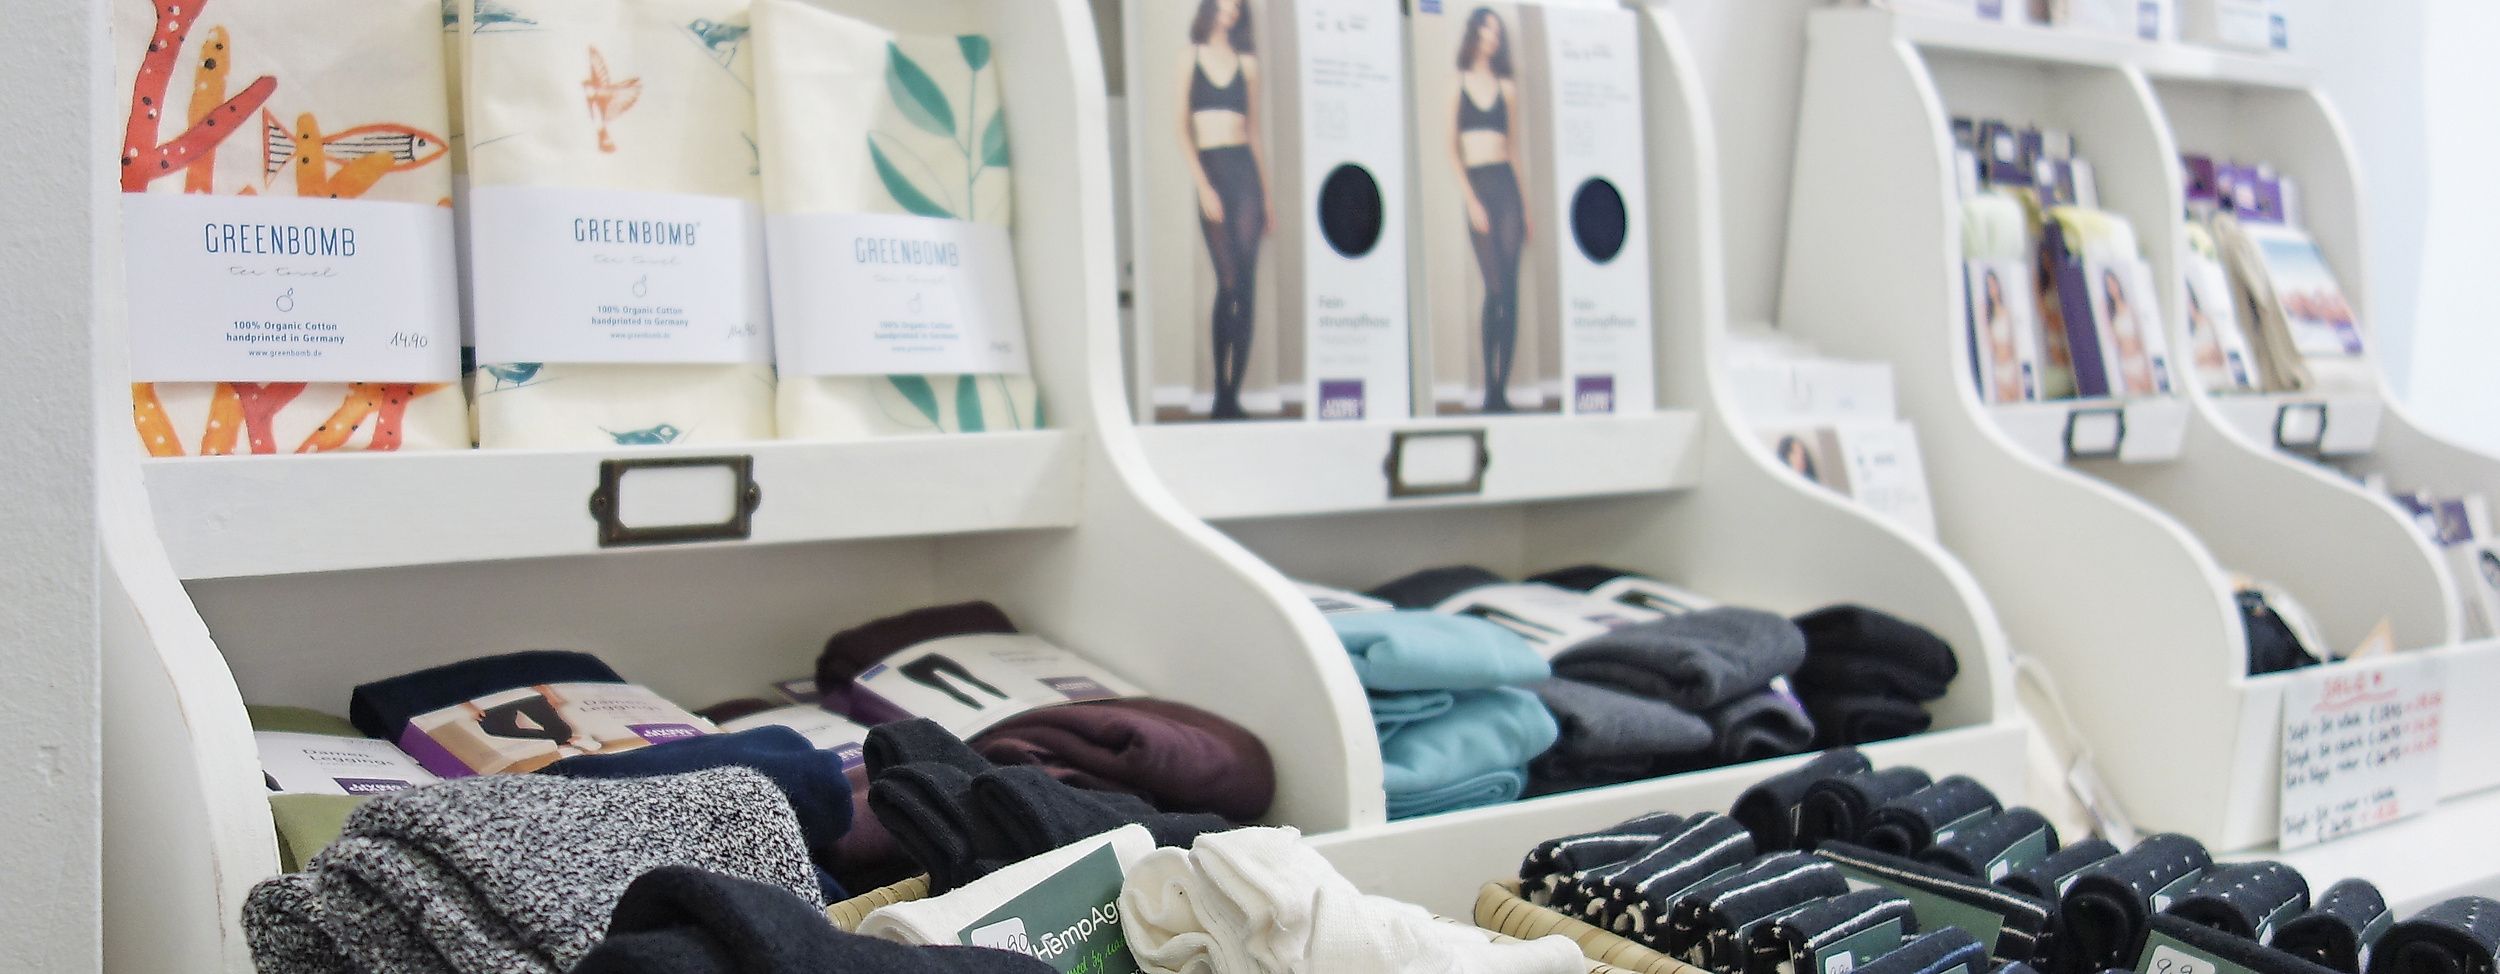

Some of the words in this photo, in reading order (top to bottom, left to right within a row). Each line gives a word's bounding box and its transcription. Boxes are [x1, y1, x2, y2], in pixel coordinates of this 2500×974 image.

[574, 218, 696, 247] GREENBOMB
[205, 223, 356, 257] GREENBOMB
[855, 237, 959, 267] GREENBOMB
[598, 306, 620, 315] 100%
[622, 306, 652, 316] Organic
[656, 306, 683, 315] Cotton
[234, 321, 261, 331] 100%
[264, 321, 302, 332] Organic
[305, 321, 338, 331] Cotton
[591, 316, 642, 327] handprinted
[644, 316, 652, 326] in
[654, 317, 689, 328] Germany
[226, 333, 287, 344] handprinted
[290, 333, 300, 342] in
[303, 334, 345, 344] Germany
[248, 349, 323, 358] www.greenbomb.de
[309, 755, 395, 766] Leggings
[1032, 898, 1122, 961] HempAg
